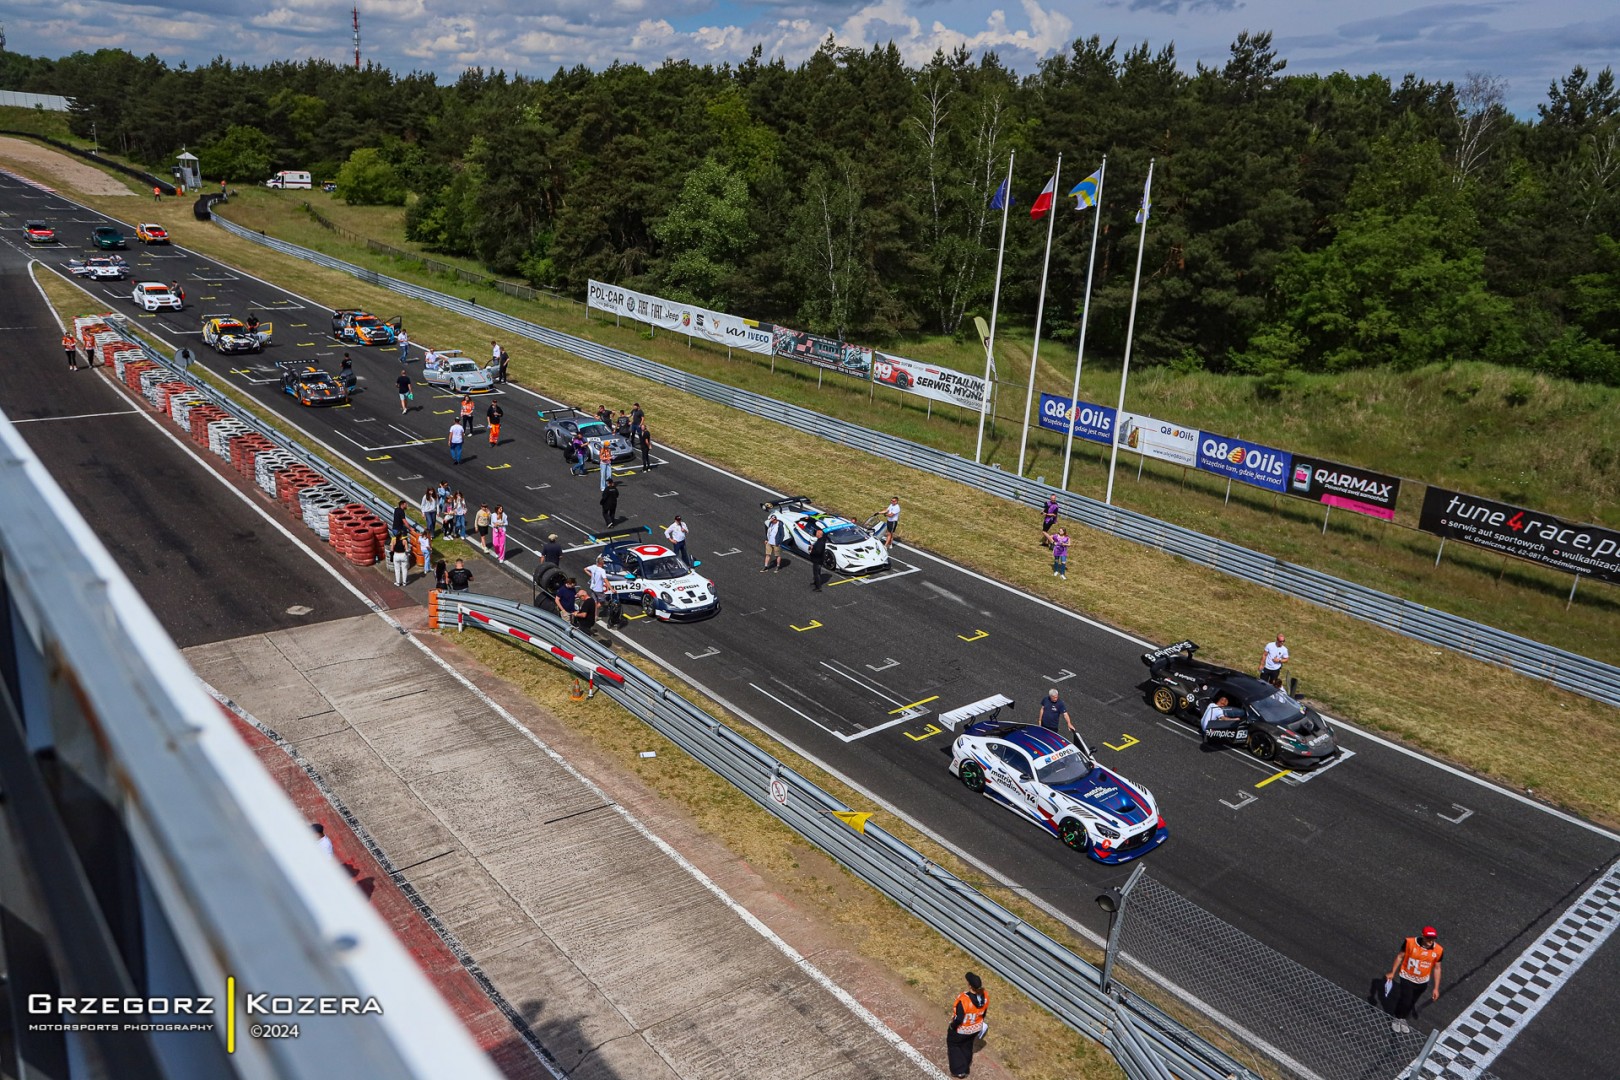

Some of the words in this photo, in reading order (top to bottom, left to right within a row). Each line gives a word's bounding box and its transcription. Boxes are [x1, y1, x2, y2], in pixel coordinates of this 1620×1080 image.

[590, 285, 624, 306] POL-CAR
[637, 299, 649, 316] FIAT
[651, 302, 663, 320] FIAT
[665, 309, 680, 322] Jeep
[345, 328, 354, 336] 30
[726, 326, 746, 337] KIA
[747, 331, 770, 344] IVECO
[916, 376, 952, 395] SERWIS,
[953, 385, 985, 402] MYJNI
[1044, 399, 1066, 419] Q8
[1080, 407, 1111, 431] Oils
[1160, 425, 1172, 436] Q8
[1178, 430, 1195, 442] Oils
[1202, 439, 1229, 460] Q8
[1245, 450, 1285, 476] Oils
[1238, 468, 1256, 478] gdzie
[1314, 469, 1393, 498] QARMAX
[1447, 519, 1477, 534] serwis
[1478, 526, 1493, 539] aut
[1494, 531, 1546, 552] sportowych
[1473, 536, 1507, 551] Graniczna
[1517, 548, 1542, 561] 62-081
[1541, 554, 1592, 574] Przeźmierowo
[628, 582, 642, 591] 29
[991, 769, 1013, 785] matrix
[1025, 792, 1037, 804] 14
